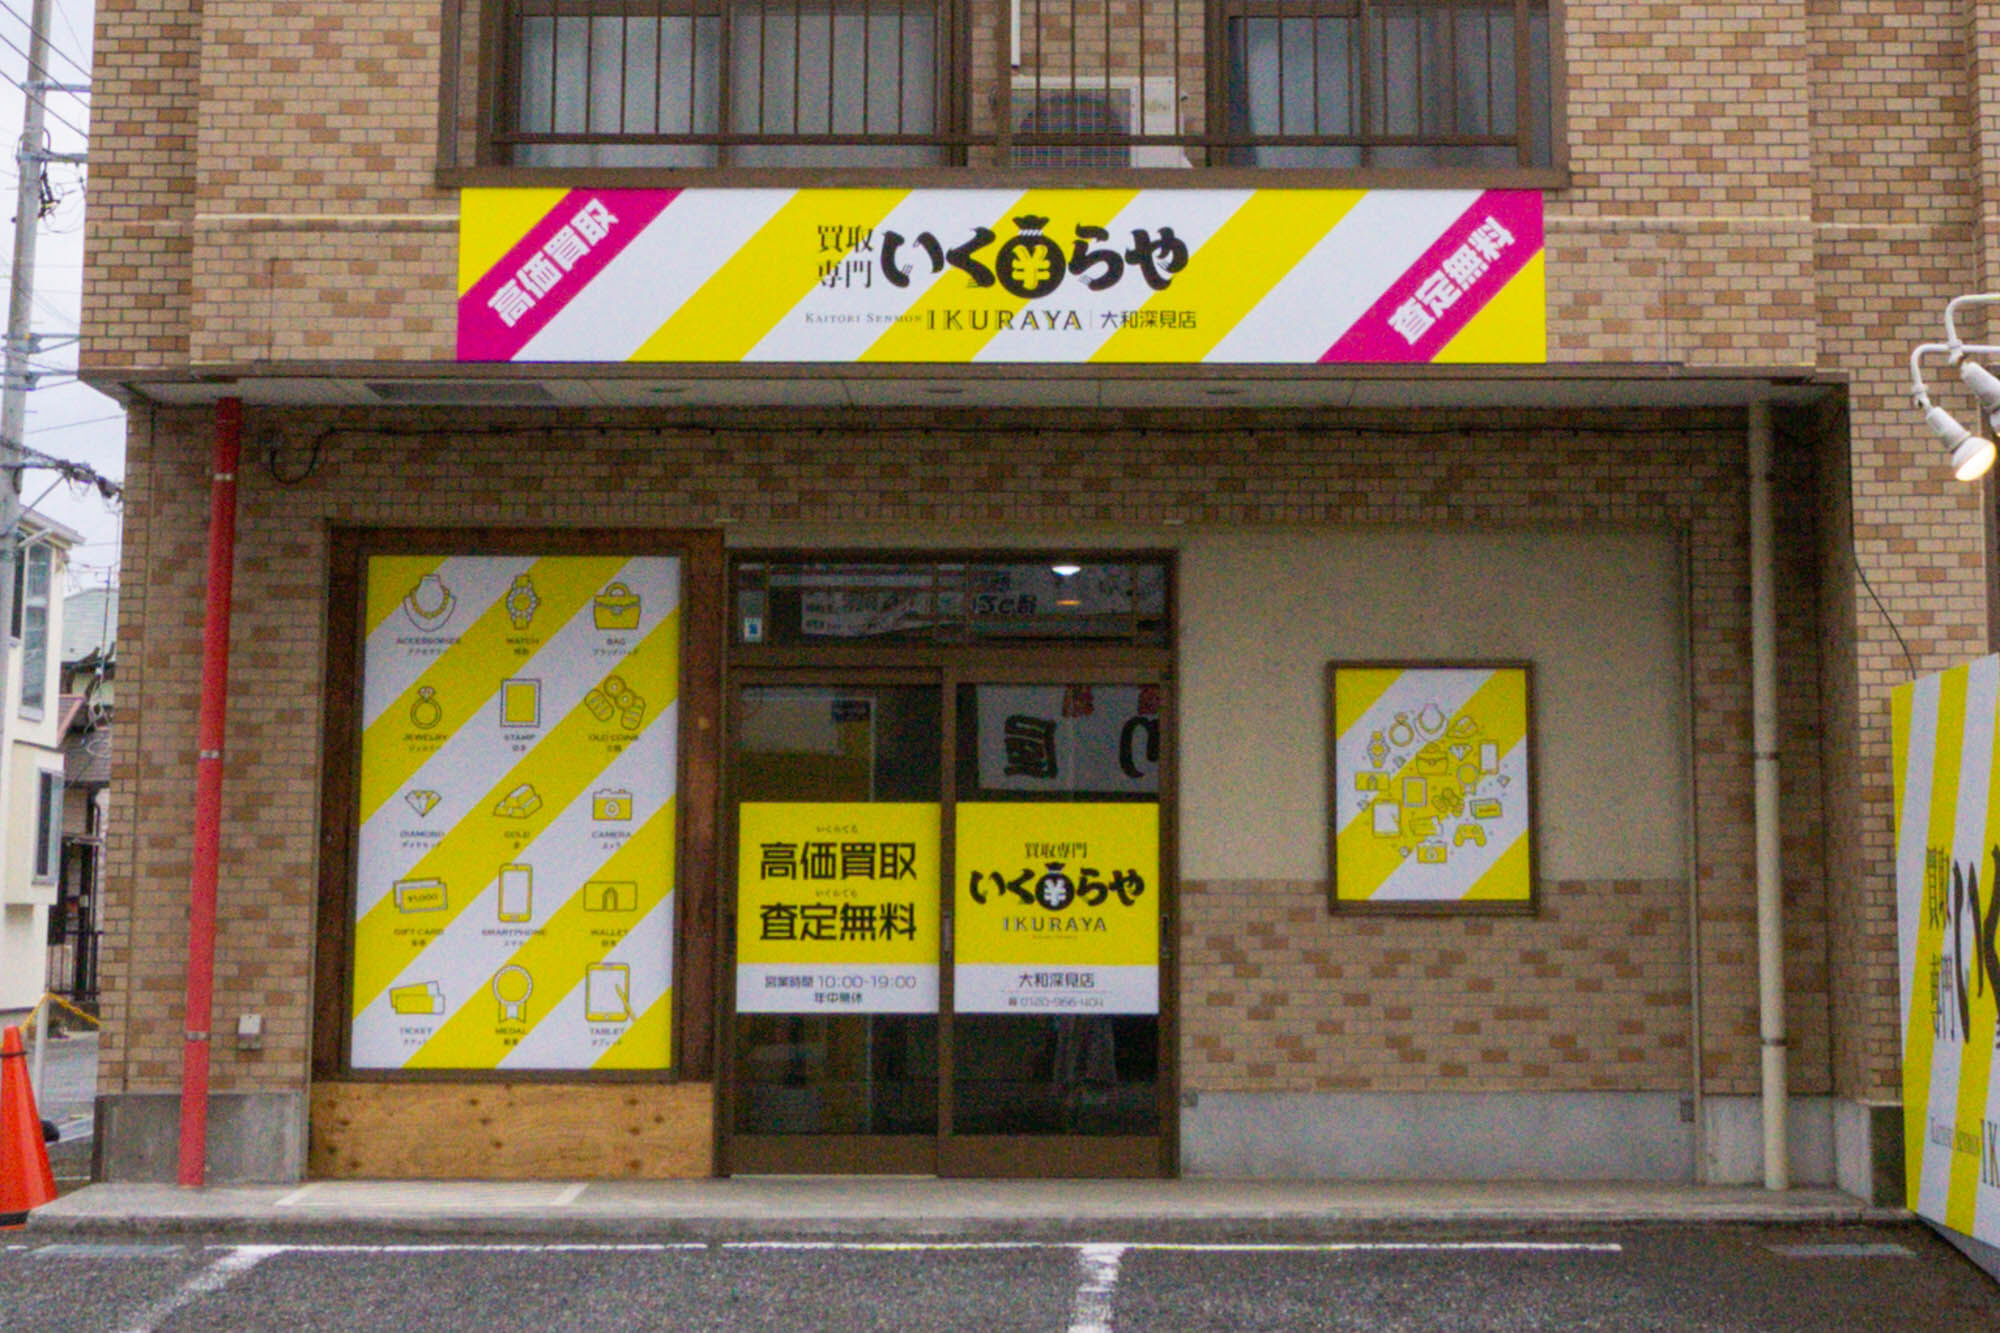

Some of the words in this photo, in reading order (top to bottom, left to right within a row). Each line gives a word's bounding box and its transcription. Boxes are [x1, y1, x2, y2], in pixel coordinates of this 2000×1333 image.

[816, 225, 874, 253] 買取
[487, 198, 620, 328] 高価買取
[816, 259, 872, 290] 専門
[1387, 216, 1516, 346] 査定無料
[927, 309, 1083, 331] IKURAYA
[1100, 309, 1197, 330] 大和深見店
[505, 637, 540, 646] WATCH
[606, 637, 626, 646] BAG
[504, 733, 535, 742] STAMP
[503, 830, 530, 839] GOLD
[591, 830, 632, 839] CAMERA
[1024, 842, 1088, 859] 買取専門
[759, 841, 917, 880] 高価買取
[759, 902, 917, 941] 査定無料
[1003, 916, 1107, 932] IKURAYA
[590, 928, 629, 937] WALLET
[818, 974, 917, 989] 10:00-19:00
[1018, 972, 1096, 989] 大和深見店
[399, 1026, 432, 1035] TICKET
[495, 1026, 527, 1035] MEDAL
[589, 1026, 626, 1035] TABLET
